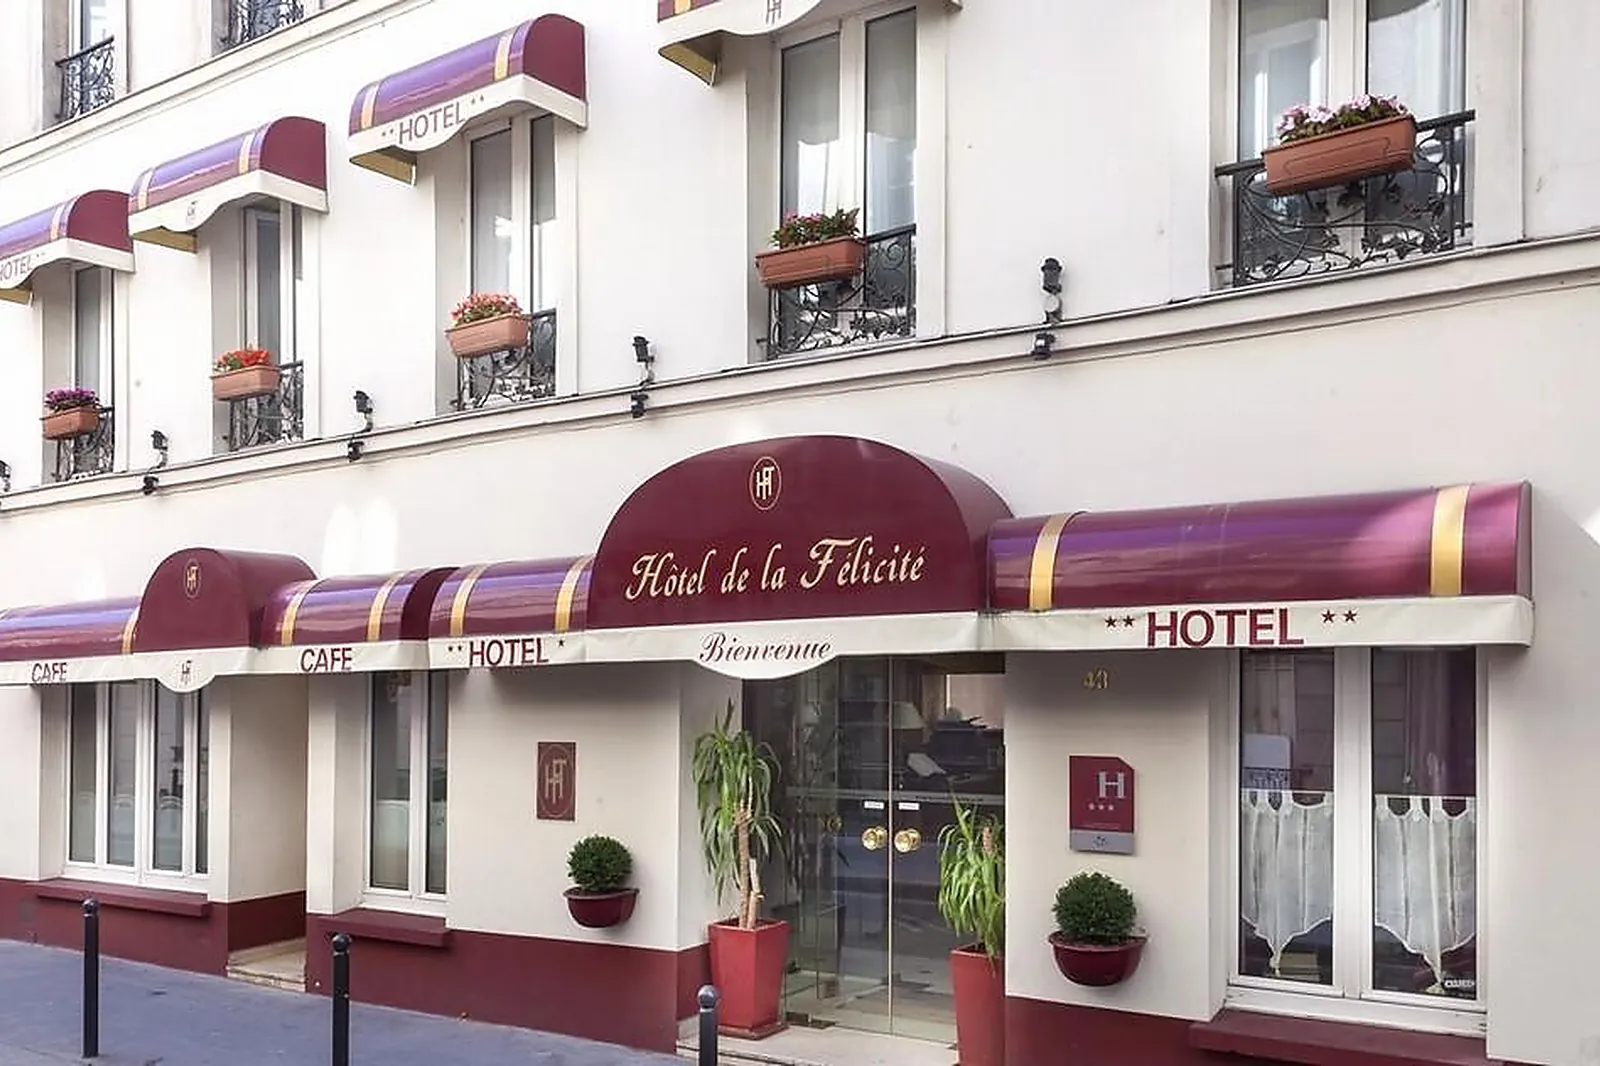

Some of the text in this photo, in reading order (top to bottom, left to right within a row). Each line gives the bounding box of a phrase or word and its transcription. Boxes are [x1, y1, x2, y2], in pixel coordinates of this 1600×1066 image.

[399, 101, 466, 145] HOTEL
[625, 535, 925, 600] Hôtel de la Félicité
[1147, 608, 1304, 648] HOTEL
[301, 647, 352, 672] CAFE
[469, 637, 549, 667] HOTEL
[699, 632, 832, 662] Bienvenue
[32, 662, 67, 683] CAFE
[1098, 771, 1125, 799] H
